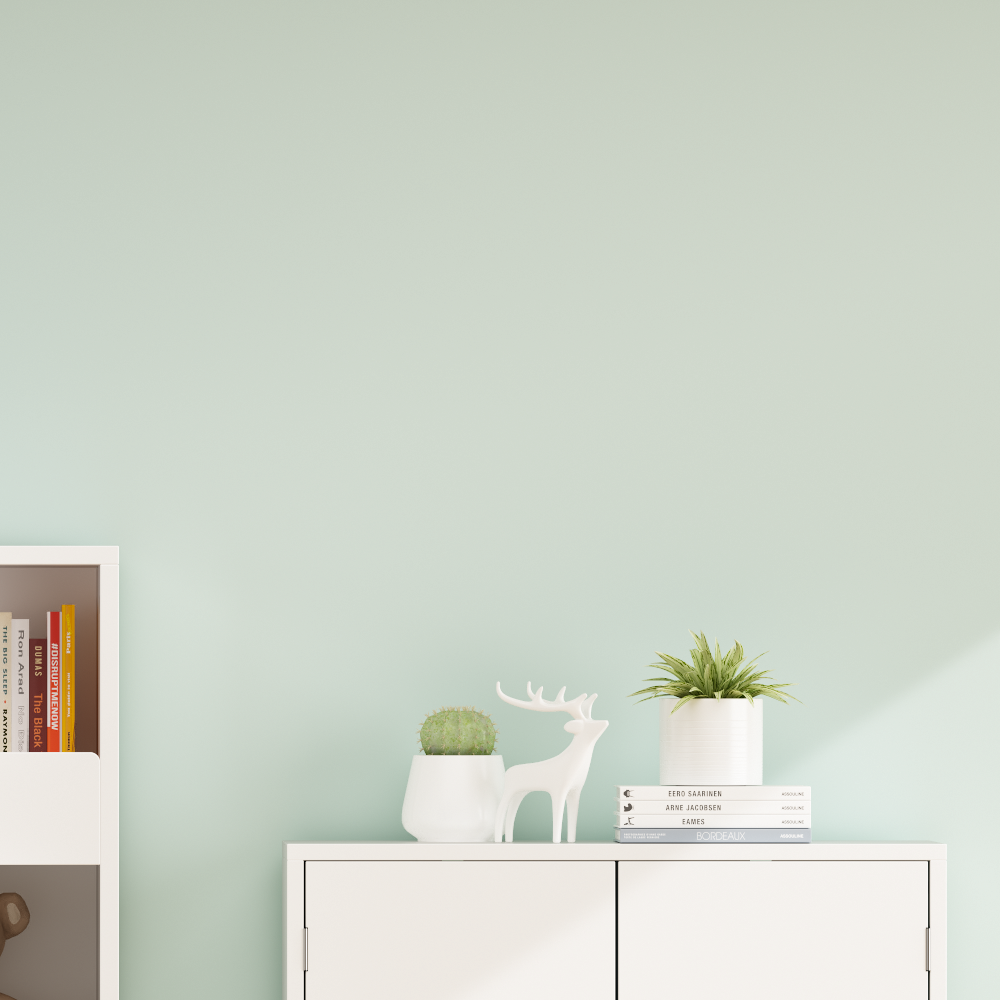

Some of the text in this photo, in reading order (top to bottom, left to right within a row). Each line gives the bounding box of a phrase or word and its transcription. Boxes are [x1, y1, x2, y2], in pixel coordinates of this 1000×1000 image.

[34, 646, 43, 677] DUMAS
[51, 643, 59, 731] #DISRUPTMENOW
[18, 705, 25, 725] No
[33, 693, 43, 748] The Black
[696, 831, 746, 841] BORDEAUX
